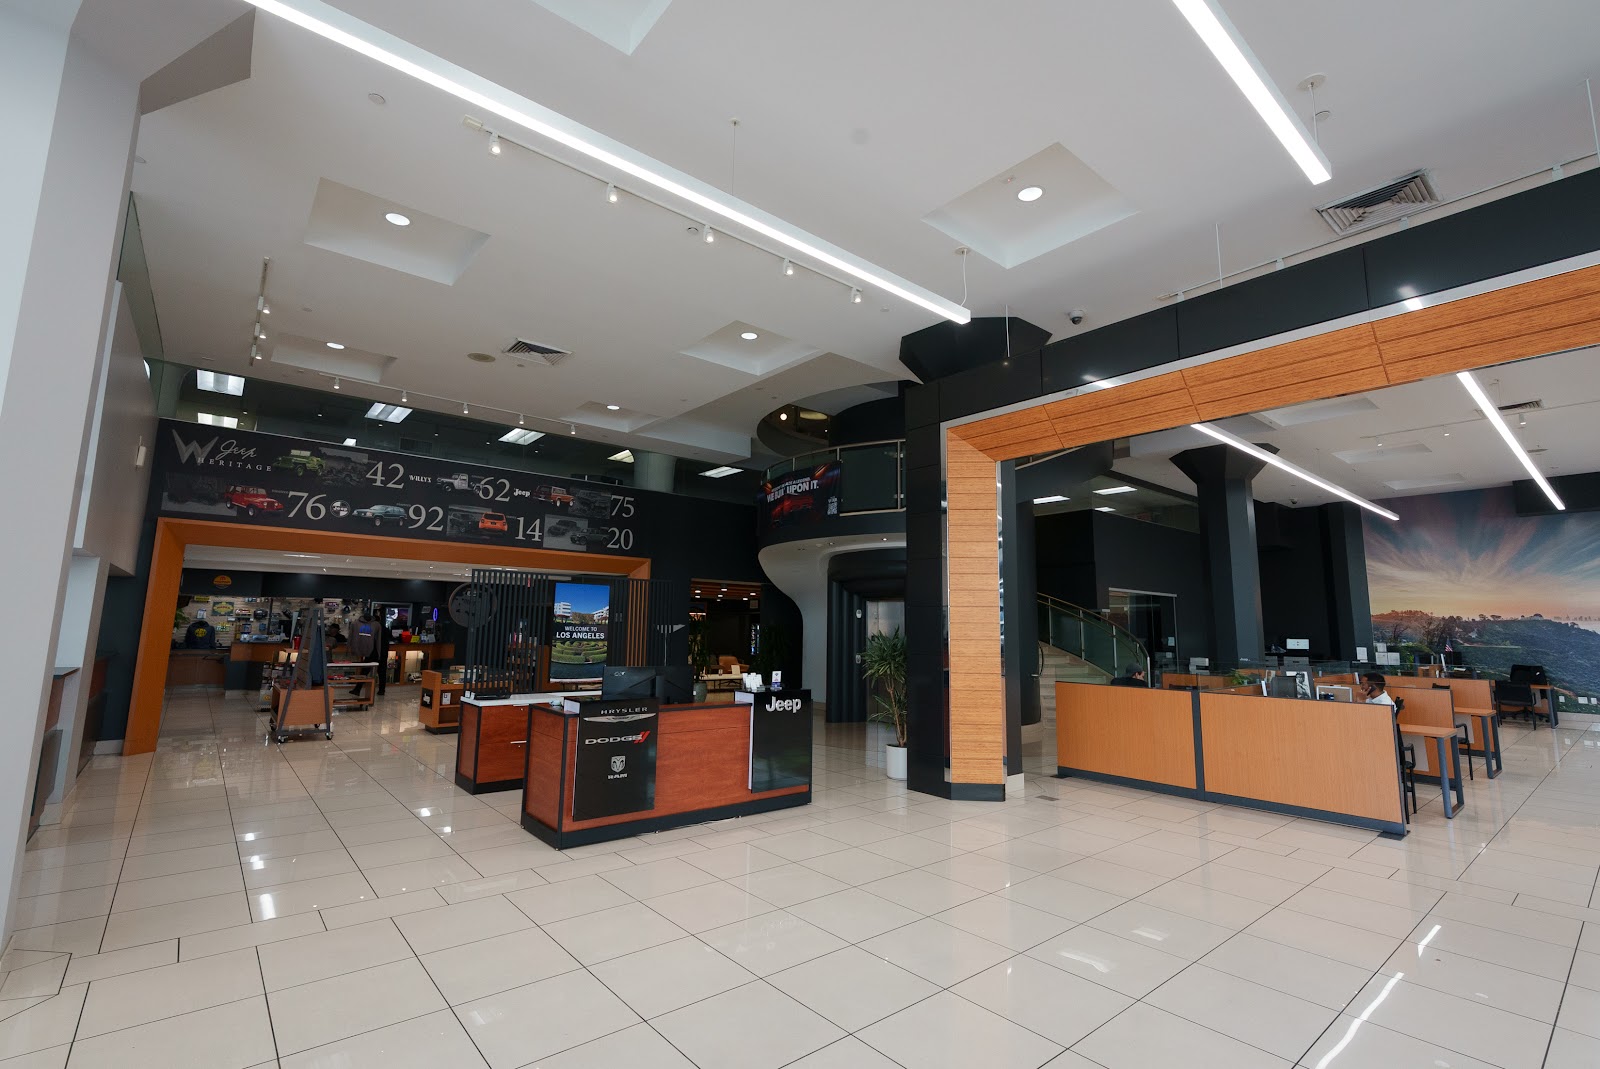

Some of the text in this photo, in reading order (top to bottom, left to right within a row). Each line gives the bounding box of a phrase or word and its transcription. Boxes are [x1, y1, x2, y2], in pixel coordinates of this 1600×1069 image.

[215, 439, 257, 460] Jeep
[197, 457, 272, 472] HERITAGE
[365, 461, 405, 489] 42
[479, 477, 511, 502] 62
[786, 482, 809, 494] UPON
[810, 480, 819, 490] IT.
[287, 491, 327, 520] 76
[611, 494, 635, 518] 75
[408, 504, 444, 531] 92
[515, 517, 543, 541] 14
[606, 527, 634, 550] 20
[556, 631, 571, 639] LOS
[765, 696, 802, 713] Jeep
[585, 735, 642, 745] DODGE
